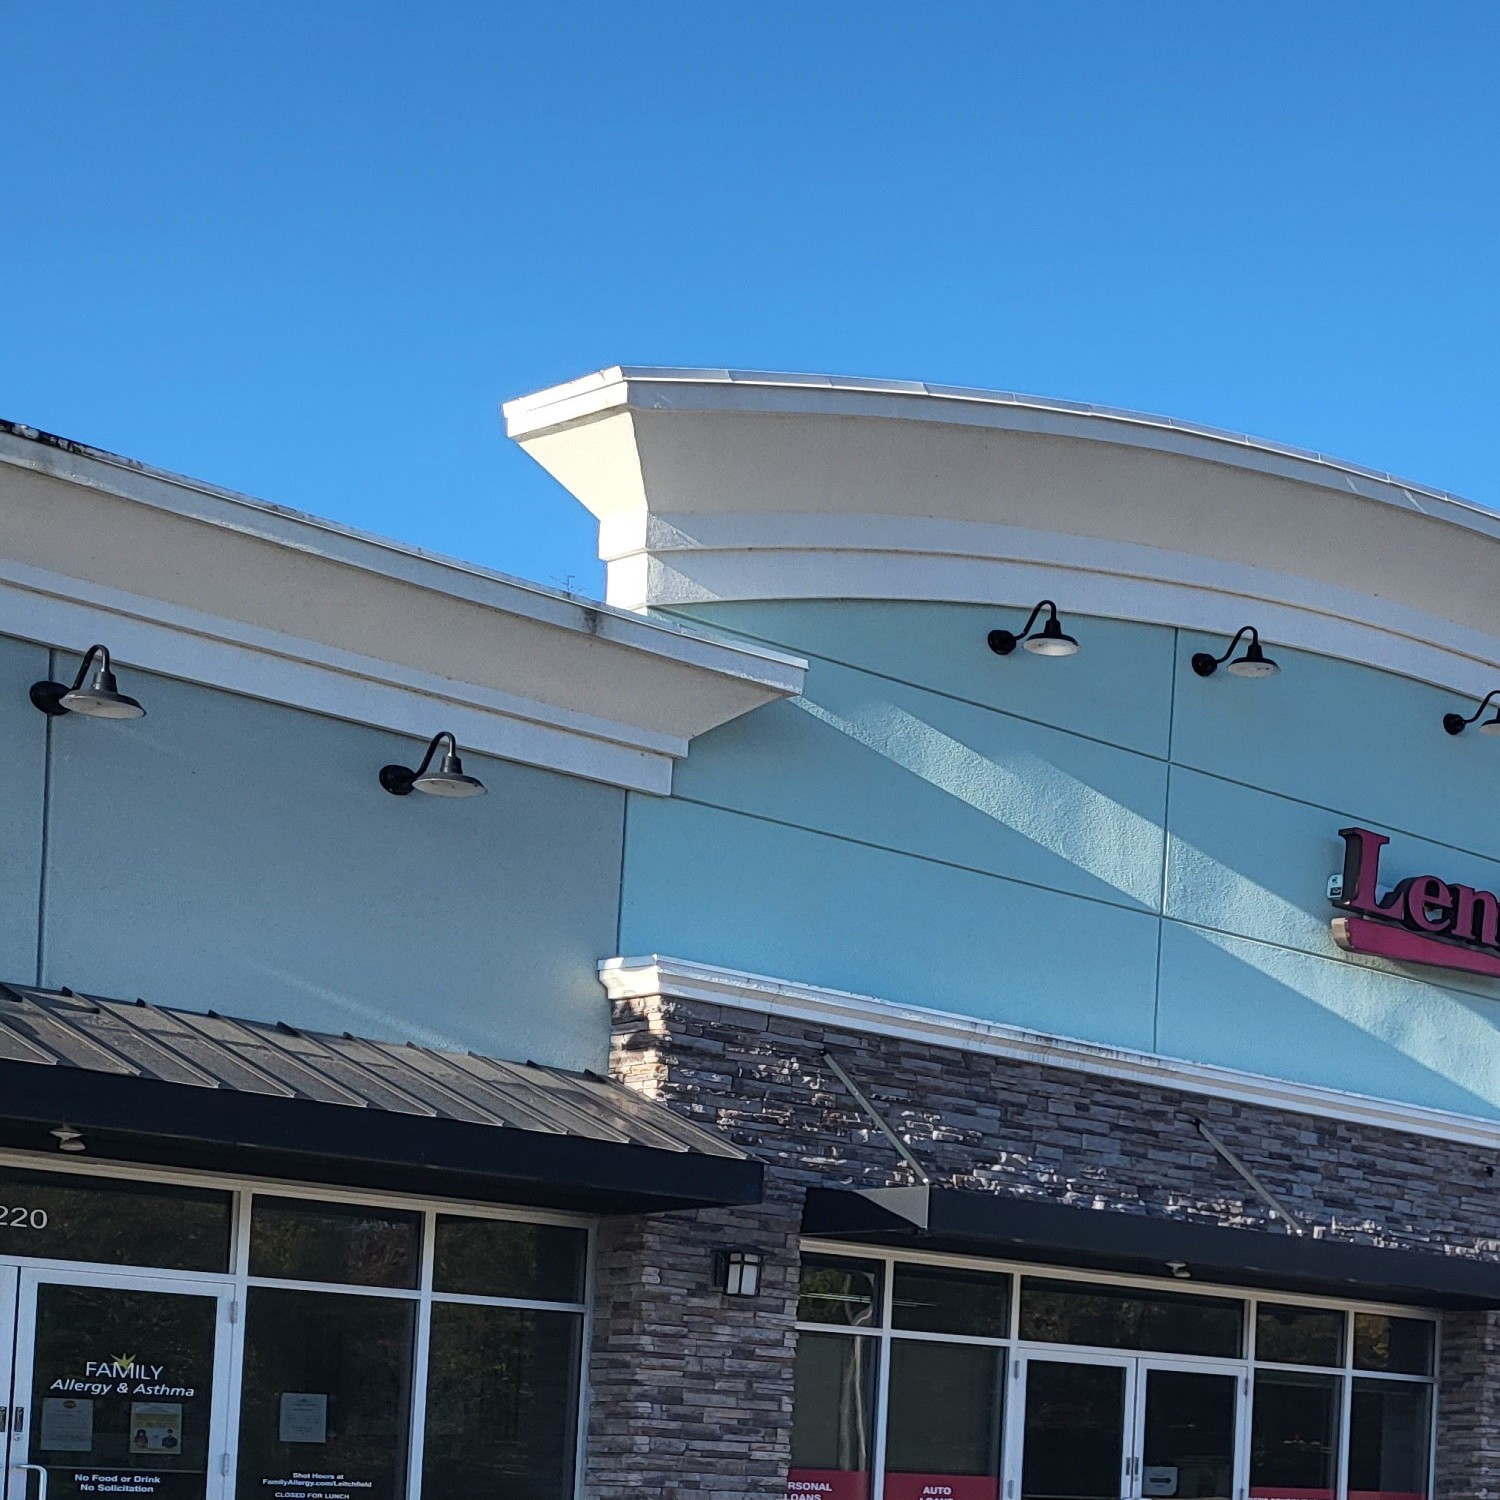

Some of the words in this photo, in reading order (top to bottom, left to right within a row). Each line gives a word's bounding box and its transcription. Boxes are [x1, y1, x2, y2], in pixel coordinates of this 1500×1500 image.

[85, 1360, 164, 1381] FAMILY
[49, 1378, 113, 1396] Allergy
[115, 1382, 129, 1394] &
[132, 1383, 196, 1397] Asthma
[74, 1473, 89, 1482] No
[91, 1474, 118, 1483] Food
[133, 1475, 161, 1484] Drink
[80, 1483, 95, 1491] No
[97, 1484, 154, 1493] Solicitation
[787, 1481, 833, 1492] RSONAL
[922, 1485, 952, 1496] AUTO
